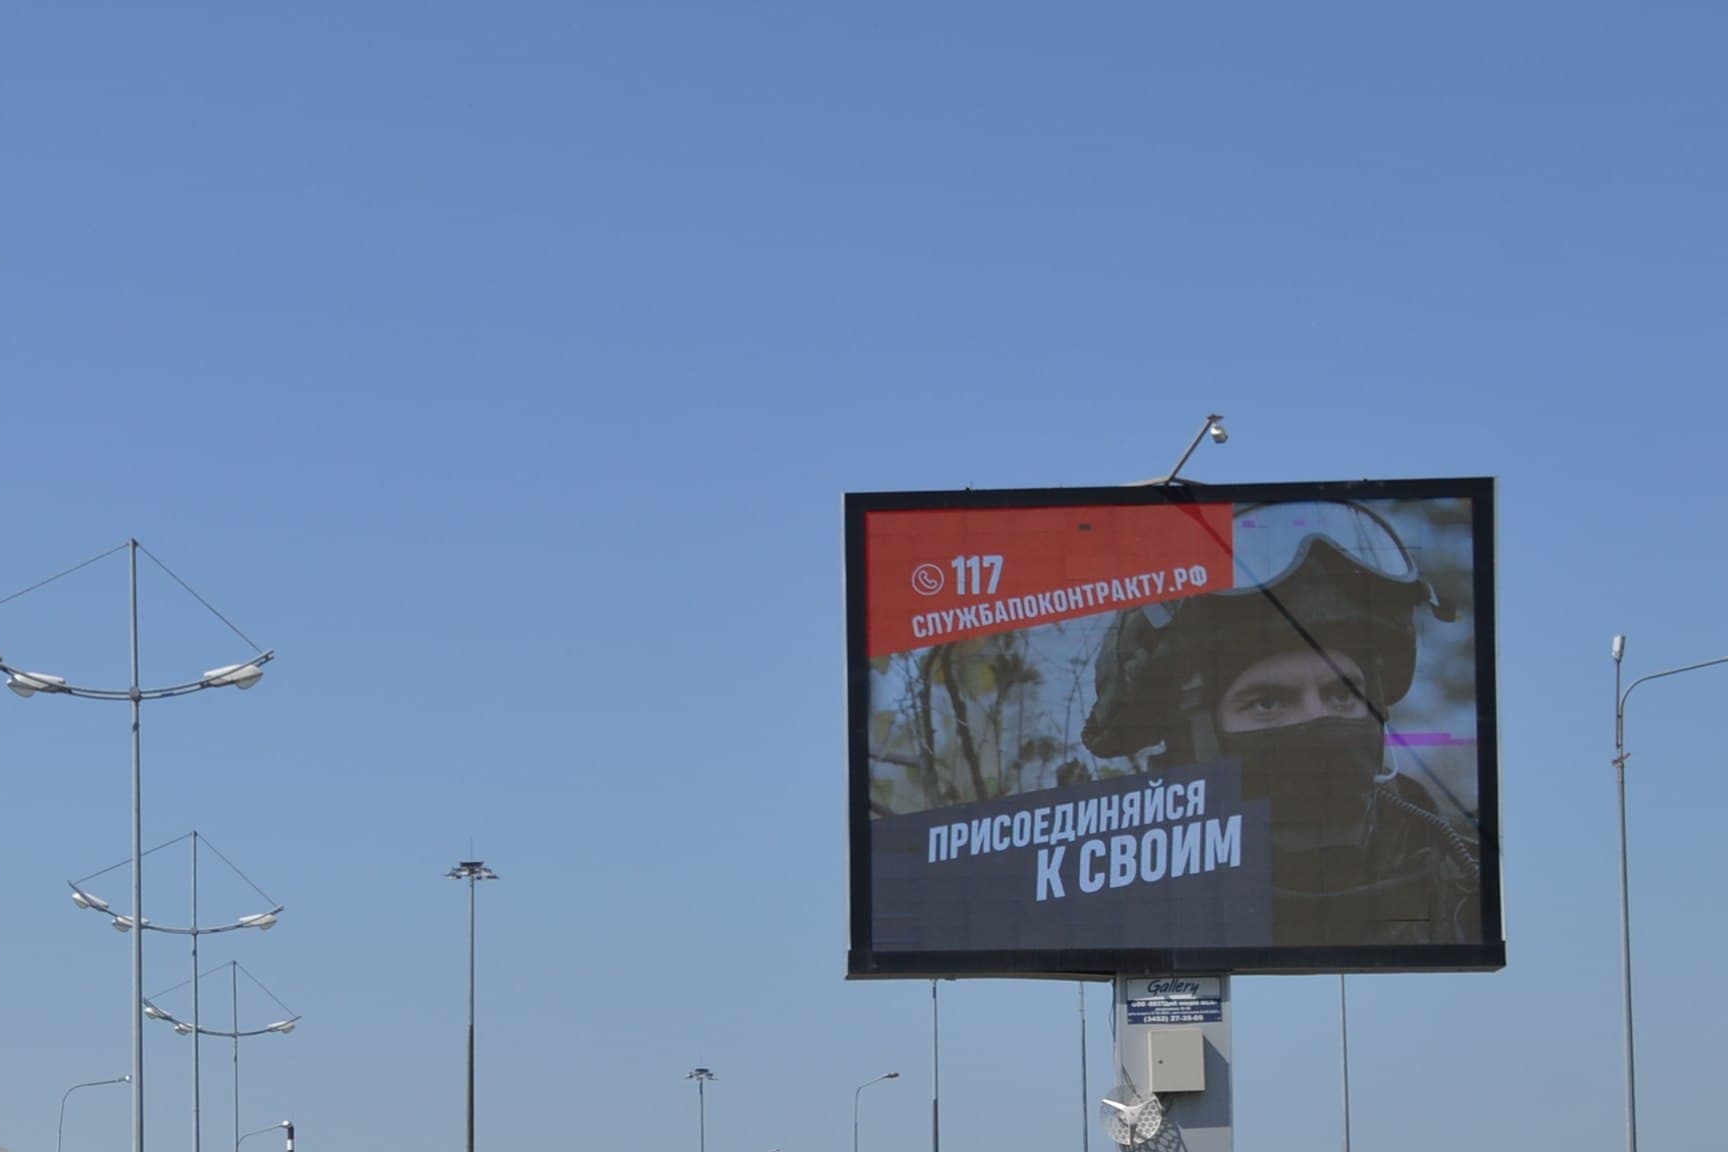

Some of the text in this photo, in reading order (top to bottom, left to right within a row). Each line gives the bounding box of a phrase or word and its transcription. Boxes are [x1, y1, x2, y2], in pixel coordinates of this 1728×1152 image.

[912, 565, 1208, 638] СЛУЖБАПОКОНТРАКТУ.РФ
[951, 555, 1004, 596] 117
[928, 778, 1206, 864] ПРИСОЕДИНЯЙСЯ
[1036, 814, 1243, 902] К СВОИМ
[1147, 979, 1200, 996] Gallery
